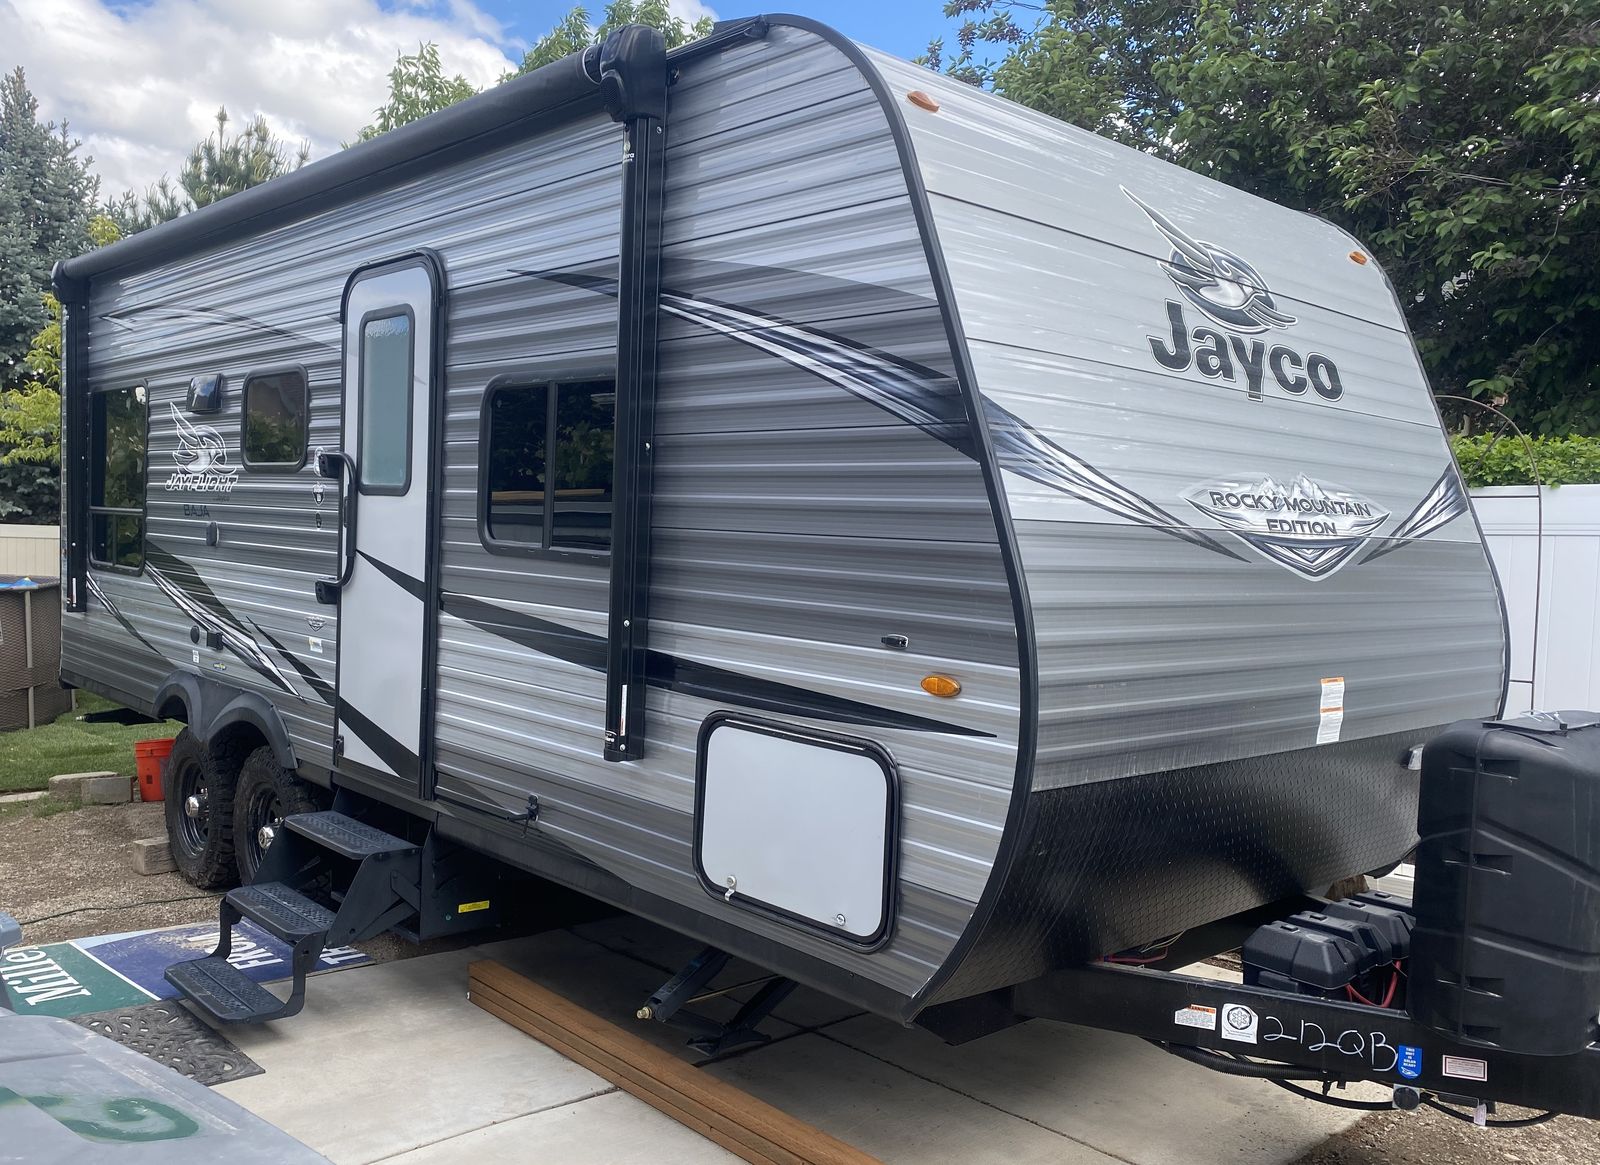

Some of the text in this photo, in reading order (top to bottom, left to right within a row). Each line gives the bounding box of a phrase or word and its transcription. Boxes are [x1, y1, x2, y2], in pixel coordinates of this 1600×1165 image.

[1146, 298, 1345, 402] Jayco
[183, 504, 210, 517] BAJA
[1208, 490, 1372, 517] ROCKY MOUNTAIN
[1266, 518, 1338, 535] EDITION
